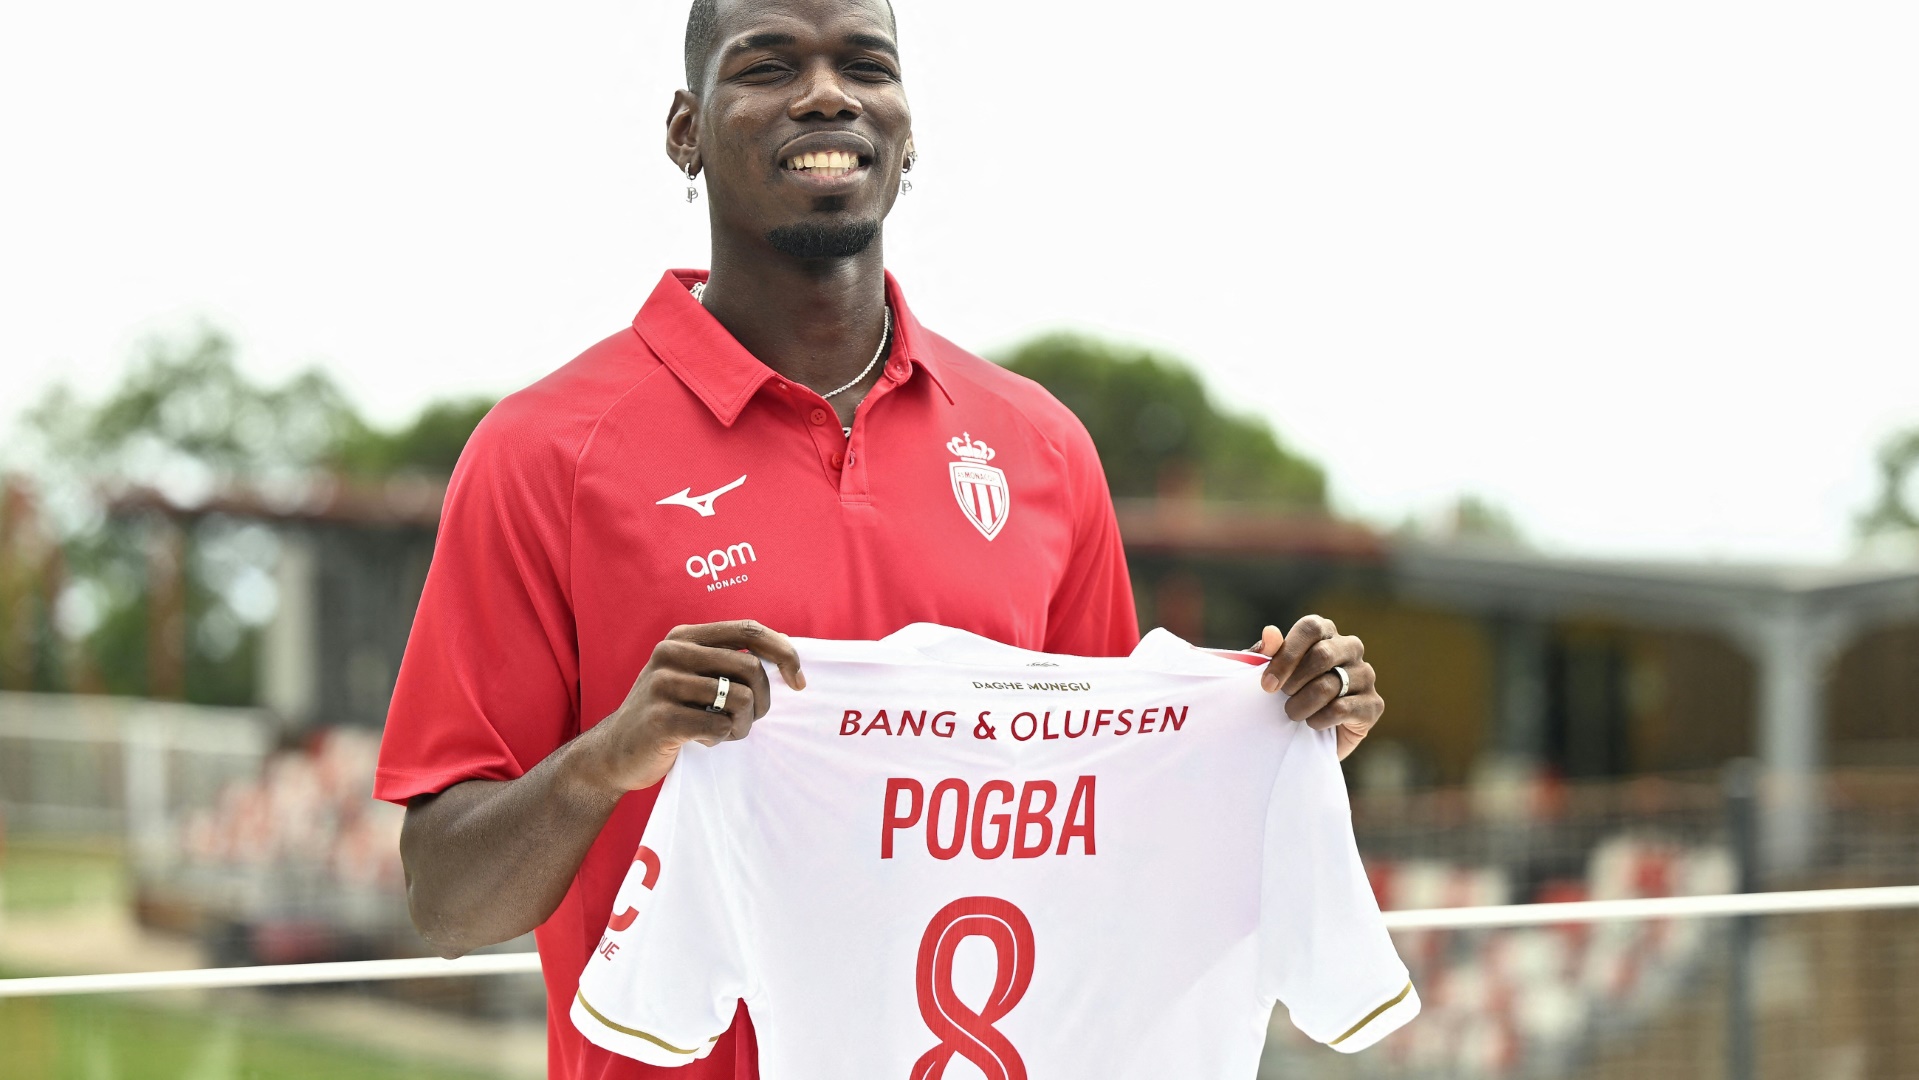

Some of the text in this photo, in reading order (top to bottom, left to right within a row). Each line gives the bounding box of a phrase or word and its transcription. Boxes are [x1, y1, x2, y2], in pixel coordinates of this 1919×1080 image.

[686, 542, 757, 581] apm
[706, 574, 749, 592] MONACO
[972, 681, 1091, 692] DAGHE MUNEGU
[839, 706, 1189, 742] BANG & OLUFSEN
[881, 775, 1097, 860] POGBA
[909, 895, 1036, 1080] 8
